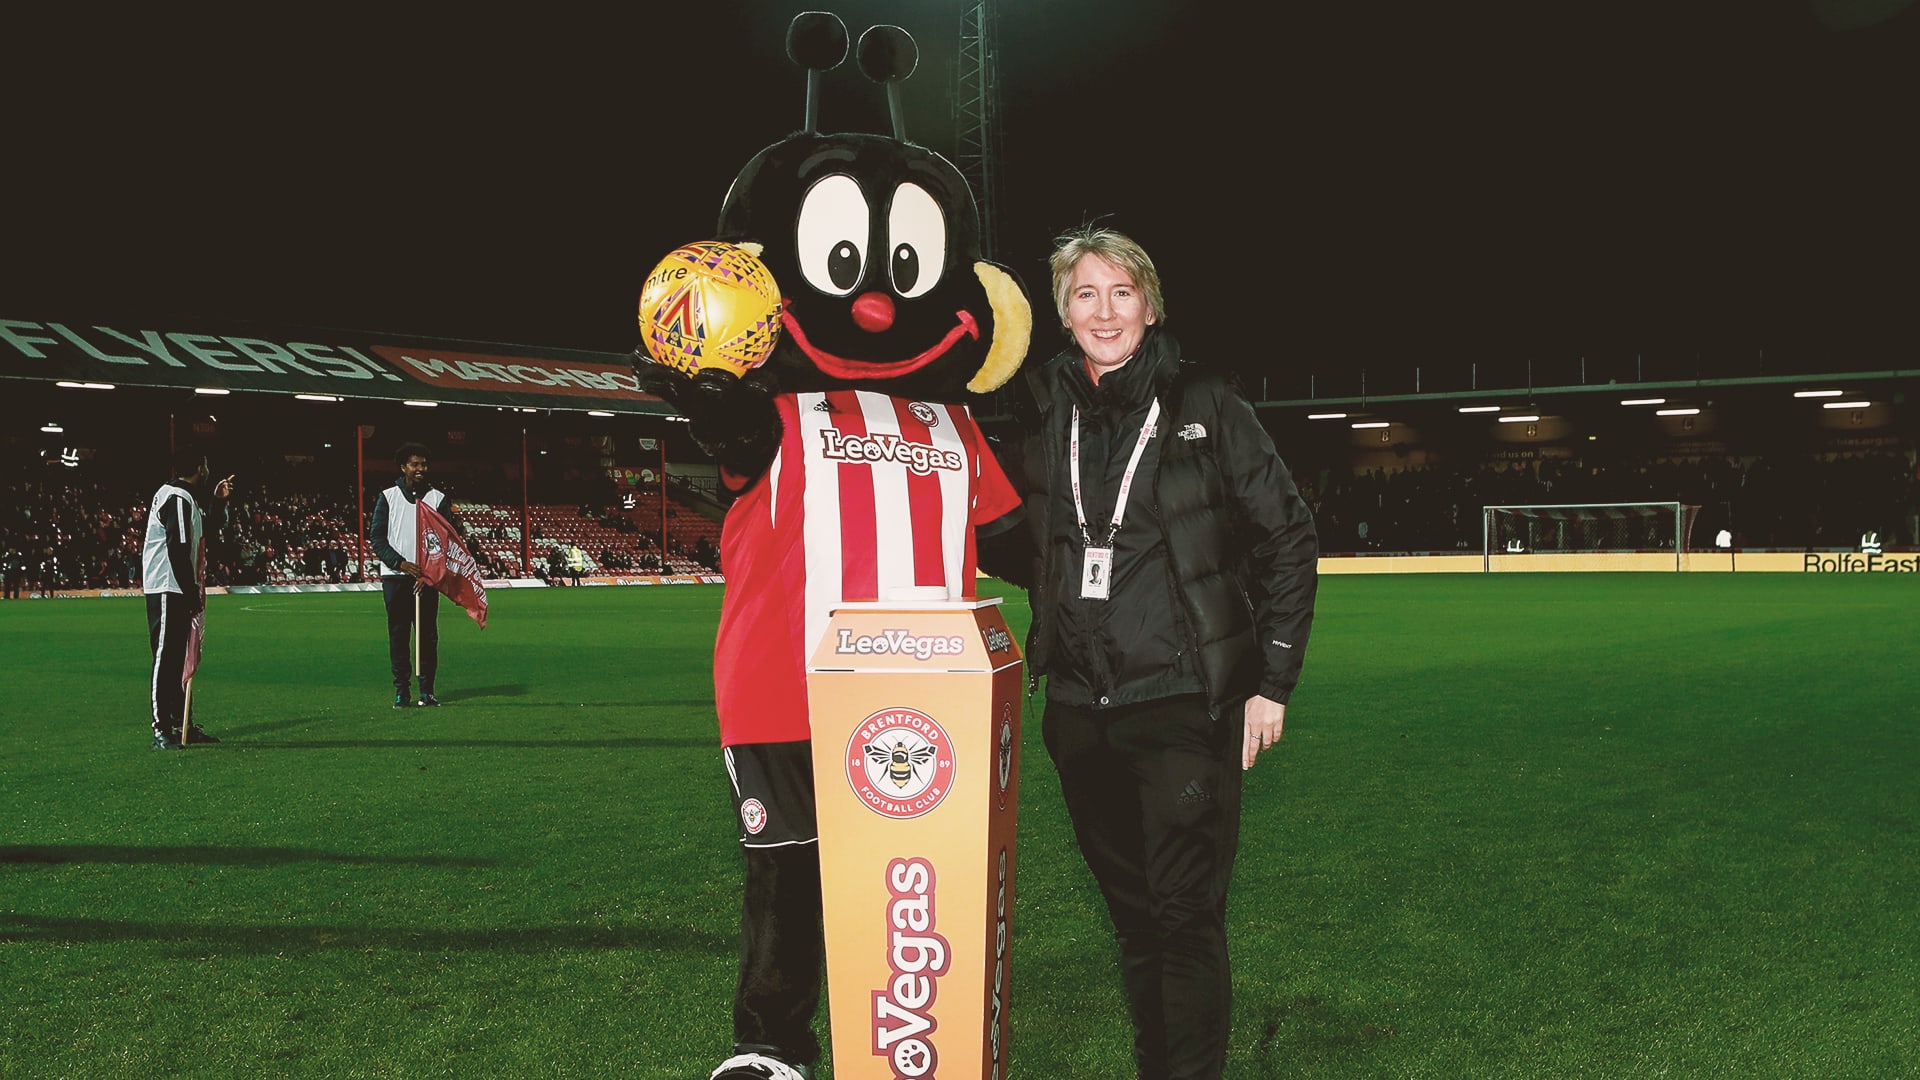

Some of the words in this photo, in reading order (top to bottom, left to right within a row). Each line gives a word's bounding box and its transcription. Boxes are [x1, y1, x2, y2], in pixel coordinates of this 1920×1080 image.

[0, 319, 401, 381] FLYERS!
[401, 355, 643, 393] MATCHBO
[821, 430, 962, 474] LeoVegas
[1521, 450, 1534, 458] on
[837, 629, 964, 660] LeoVegas
[861, 714, 939, 740] BRENTFORD
[851, 759, 860, 767] 18
[939, 760, 950, 768] 89
[861, 786, 913, 813] FOOTBALL
[915, 787, 941, 809] CLUB
[876, 862, 945, 1080] oVegas
